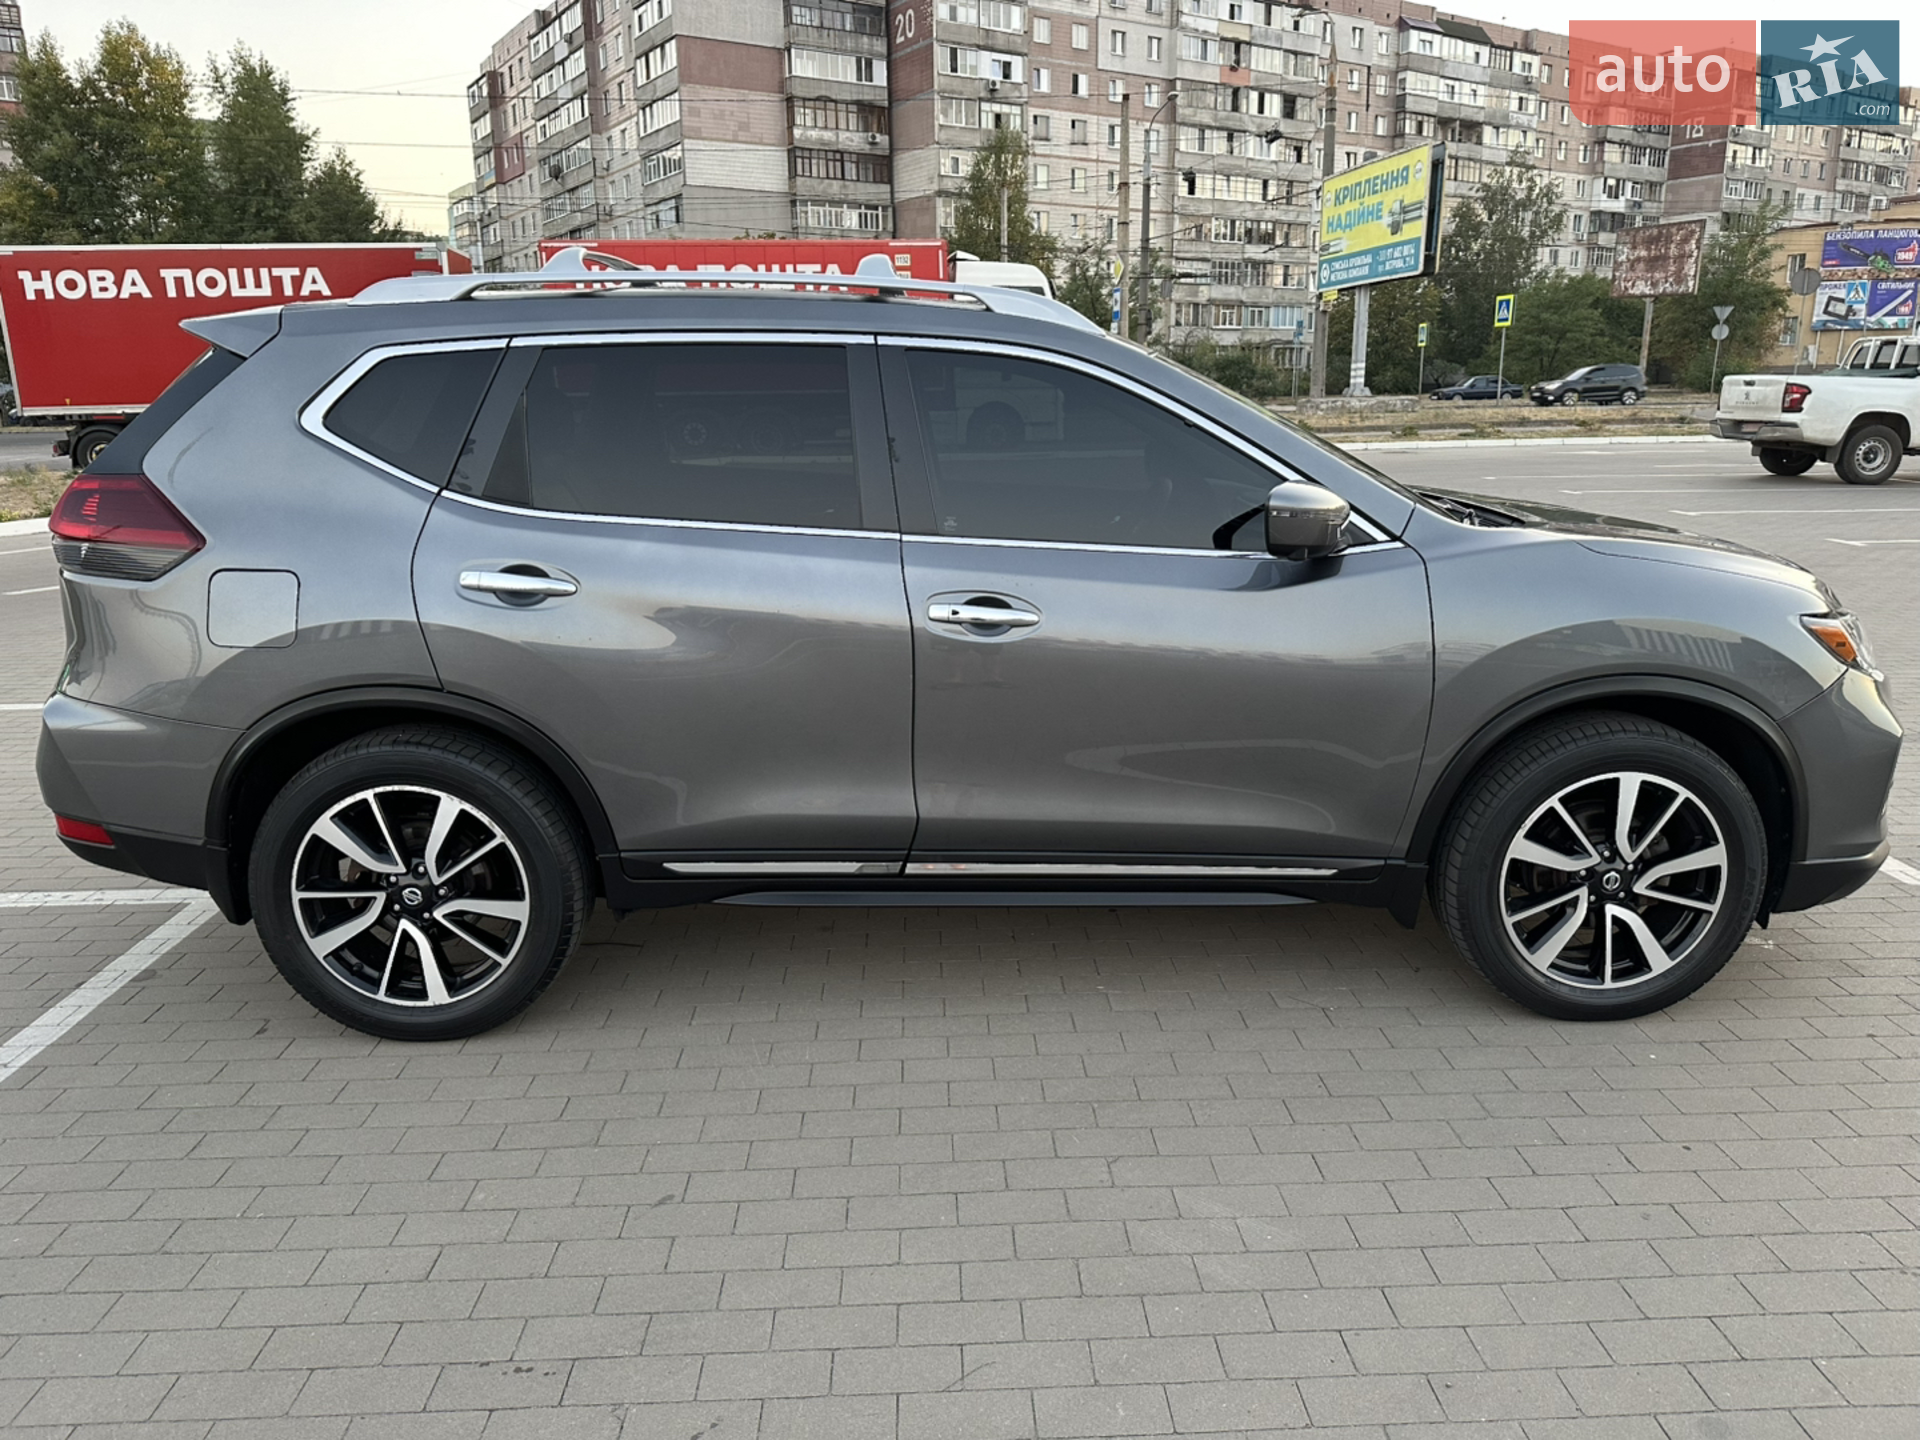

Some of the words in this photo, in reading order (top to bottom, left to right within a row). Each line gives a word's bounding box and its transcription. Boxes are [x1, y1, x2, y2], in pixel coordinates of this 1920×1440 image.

[895, 8, 915, 44] 20
[1680, 116, 1706, 139] 18
[1334, 165, 1410, 207] КРІПЛЕННЯ
[1326, 200, 1384, 234] НАДІЙНЕ
[1826, 230, 1875, 241] БЕНЗОПИЛА
[18, 269, 152, 300] НОВА
[160, 267, 332, 298] ПОШТА
